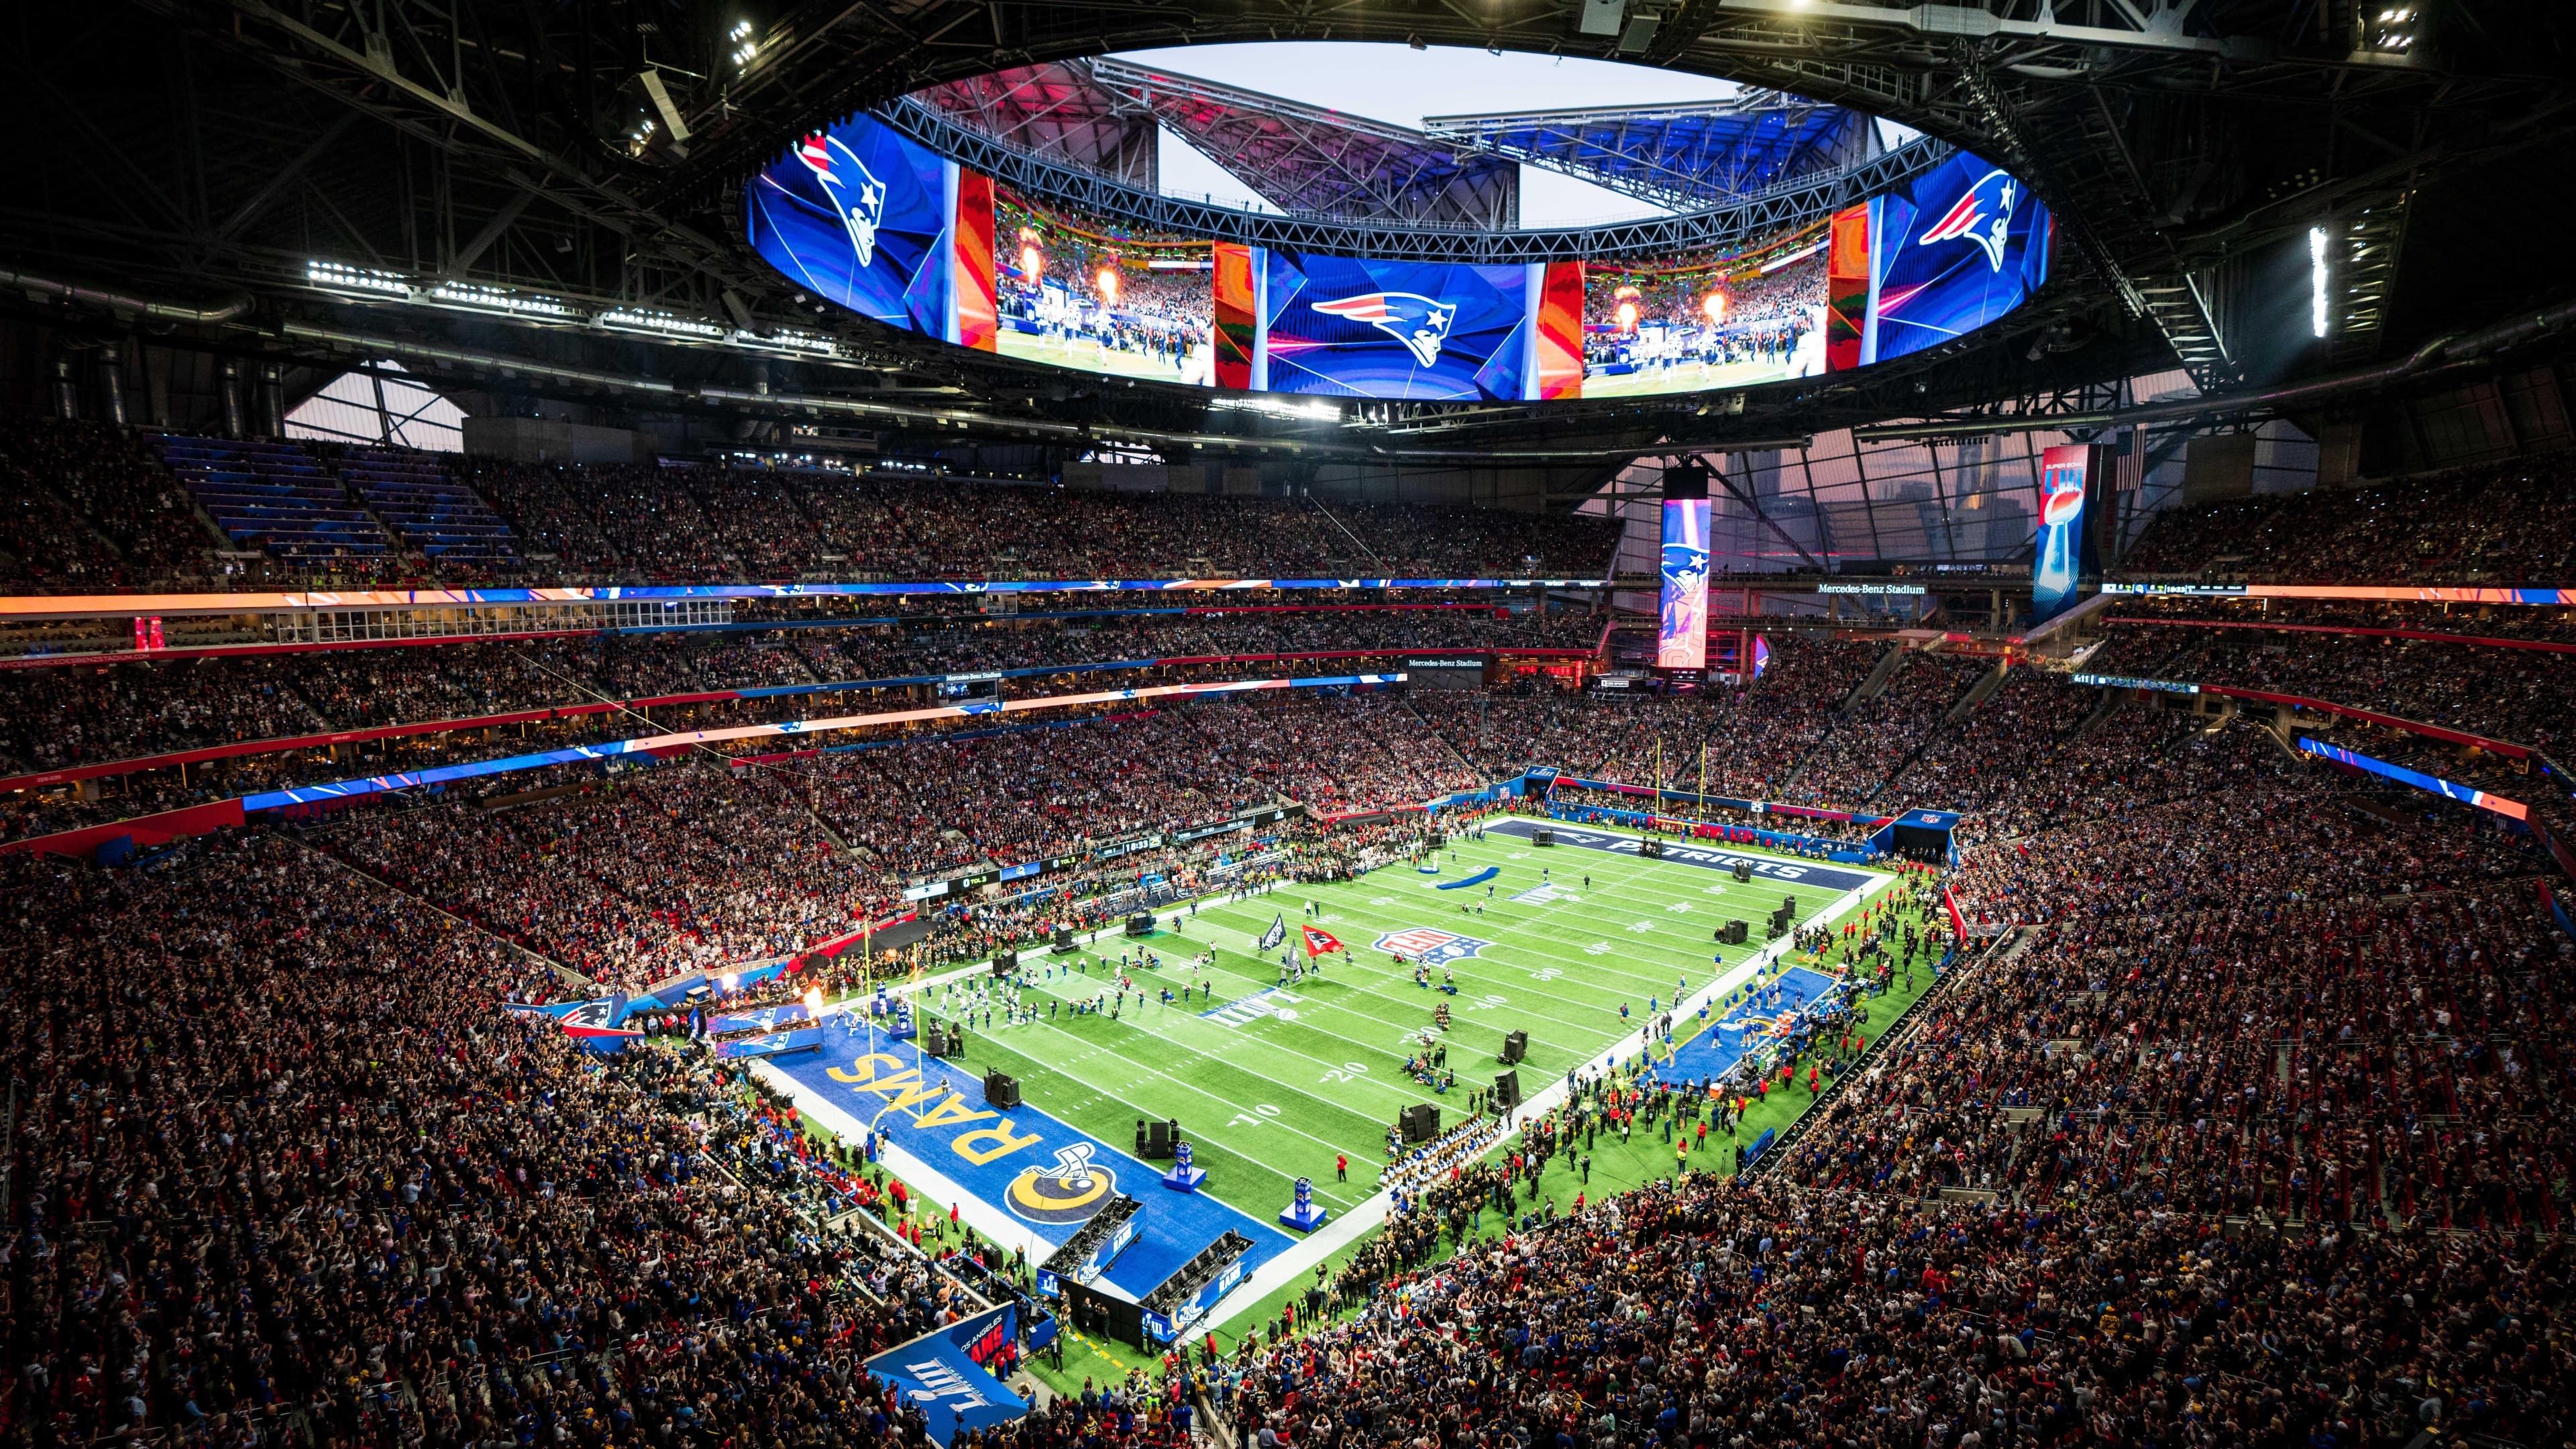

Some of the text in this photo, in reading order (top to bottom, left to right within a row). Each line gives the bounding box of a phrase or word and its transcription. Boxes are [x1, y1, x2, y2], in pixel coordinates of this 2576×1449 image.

[1819, 584, 1925, 594] Mercedes-Benz Stadium
[947, 673, 982, 681] Mercedes-Benz
[1126, 841, 1148, 852] 18:33
[1150, 837, 1161, 846] 25
[1053, 859, 1059, 868] 0
[963, 878, 970, 888] 0
[1666, 903, 1693, 914] 20
[1625, 922, 1654, 933] 30
[1380, 930, 1455, 953] NFL
[1583, 943, 1612, 955] 40
[1529, 967, 1563, 981] 50
[1474, 994, 1507, 1010] 40
[1326, 1062, 1369, 1083] 20
[826, 1053, 1043, 1166] RAMS
[1234, 1104, 1281, 1127] 10
[1114, 1226, 1132, 1253] RAMS
[1220, 1266, 1241, 1294] RAMS
[961, 1315, 1003, 1353] OS ANGELES
[965, 1324, 1003, 1364] AMS
[906, 1359, 987, 1412] LIII
[948, 1366, 984, 1397] SUPER BOWL
